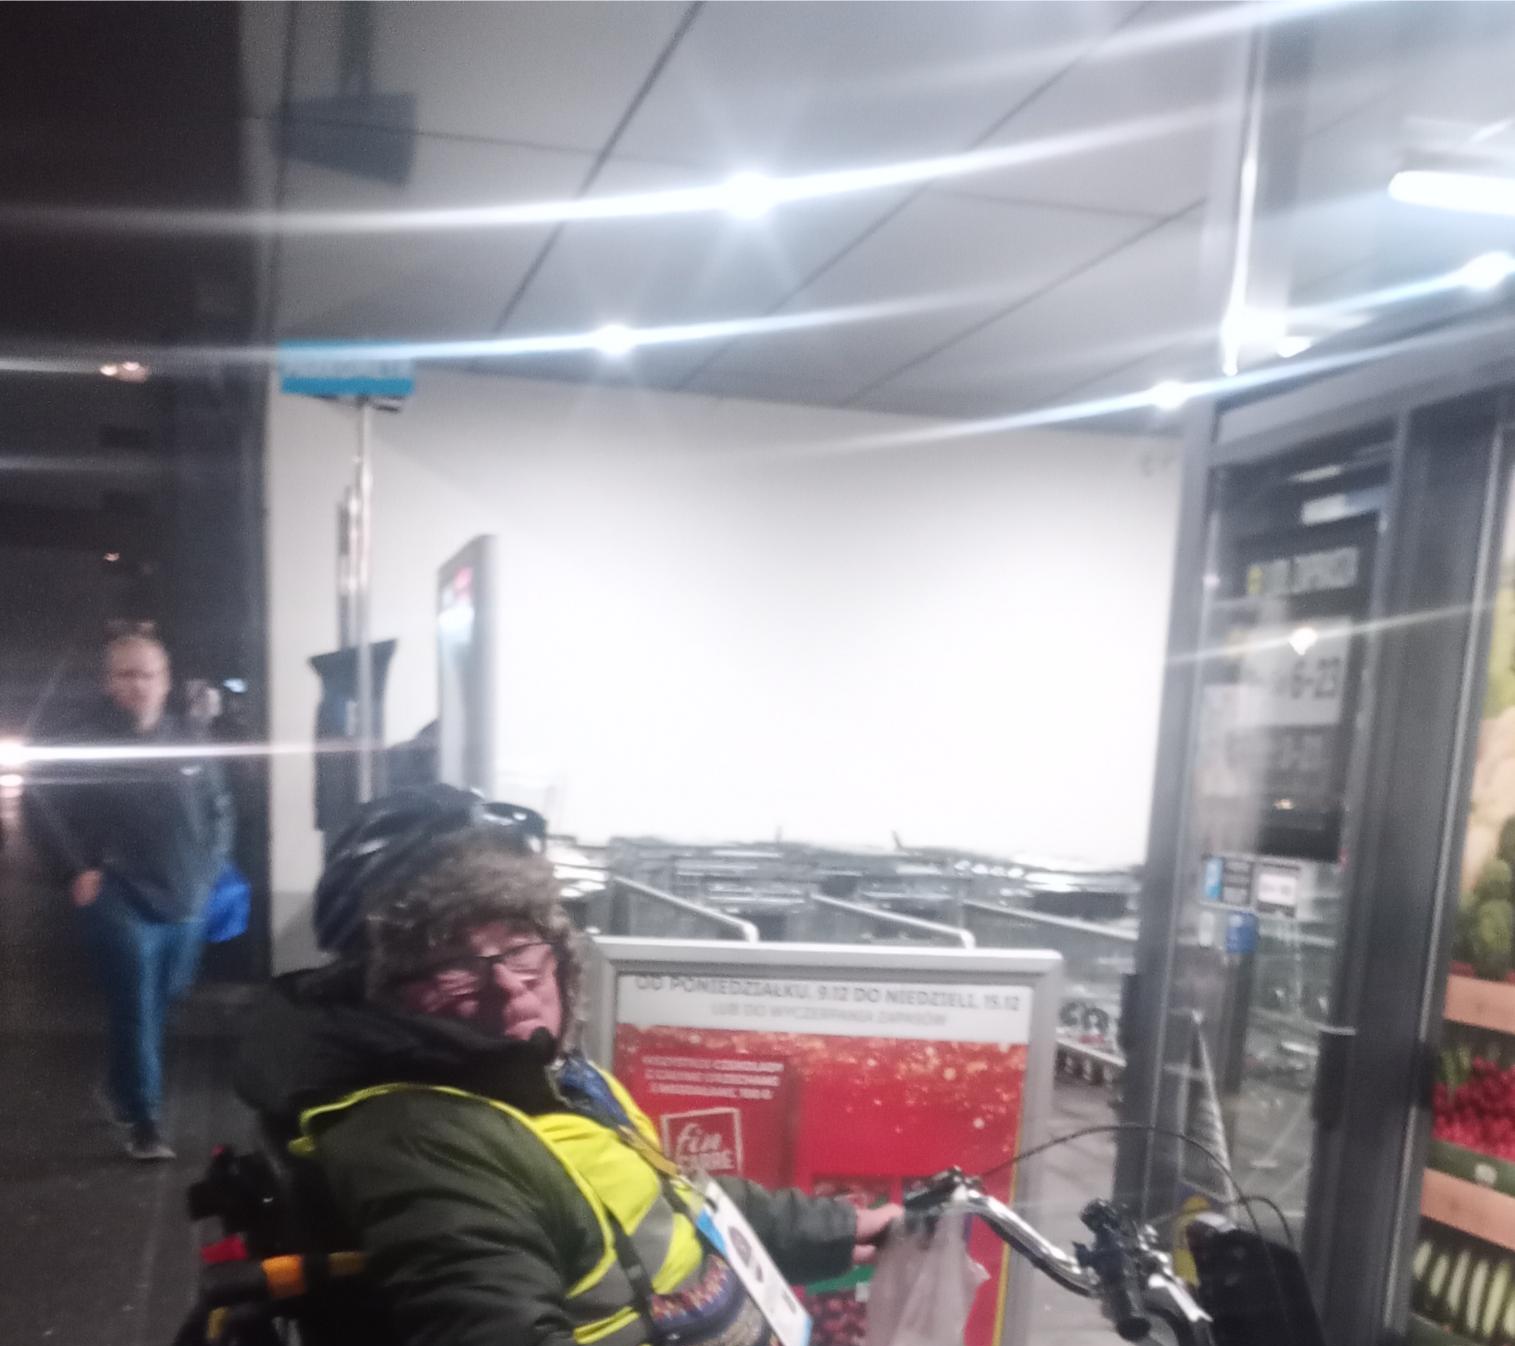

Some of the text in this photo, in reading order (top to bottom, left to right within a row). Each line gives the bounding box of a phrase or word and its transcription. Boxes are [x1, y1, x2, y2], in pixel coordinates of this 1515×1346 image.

[635, 976, 663, 991] OD
[817, 985, 848, 1001] 9.12
[854, 987, 879, 1003] DO
[984, 995, 1019, 1011] 15.12
